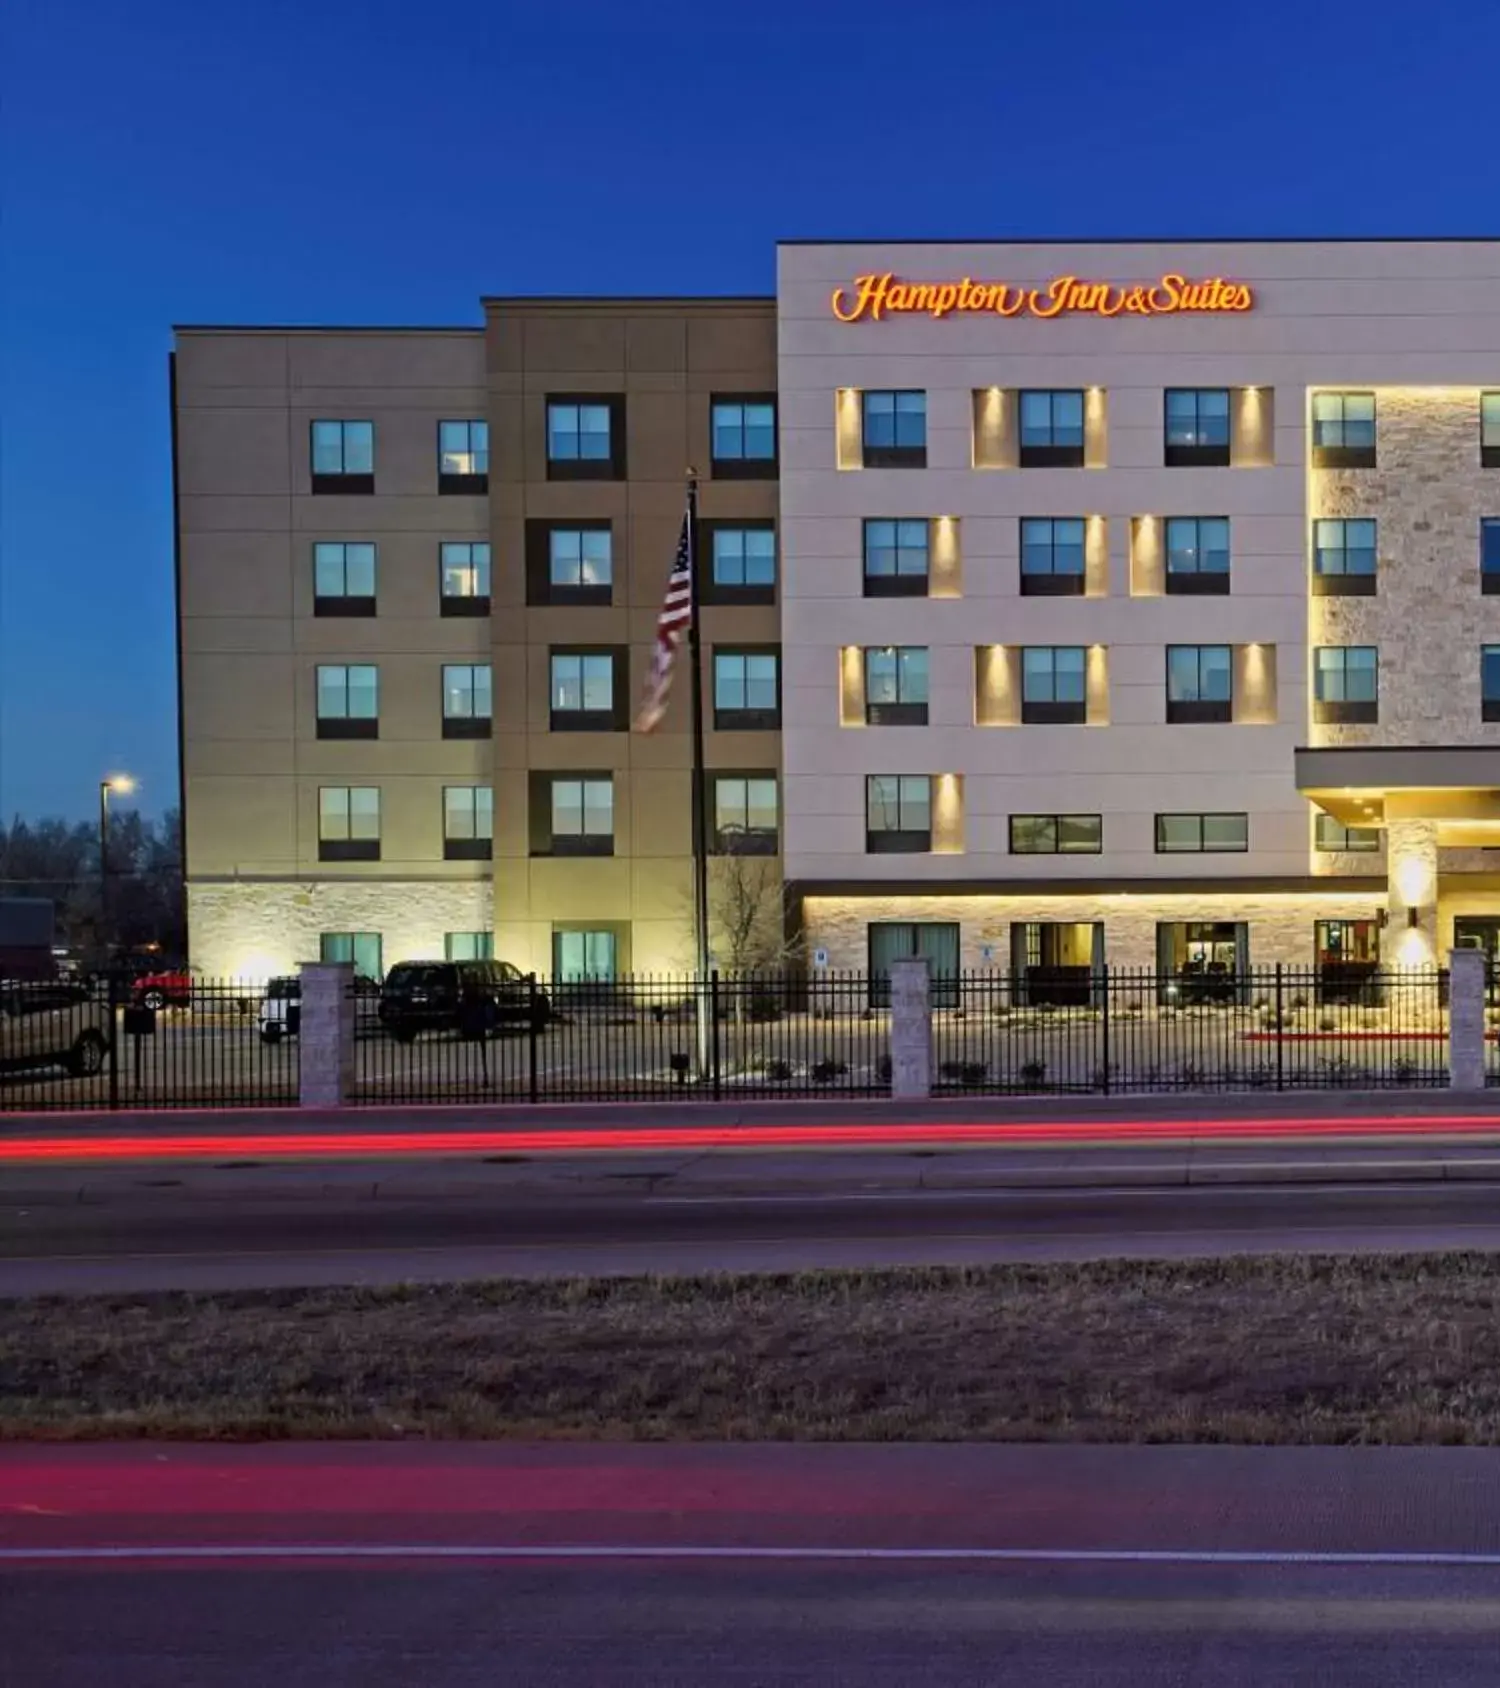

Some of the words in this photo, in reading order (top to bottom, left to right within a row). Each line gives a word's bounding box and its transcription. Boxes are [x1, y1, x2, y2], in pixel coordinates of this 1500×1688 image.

[832, 273, 1024, 321] Hampton
[1029, 275, 1125, 317] Inn
[1126, 286, 1150, 314] &
[1149, 274, 1251, 313] Suites
